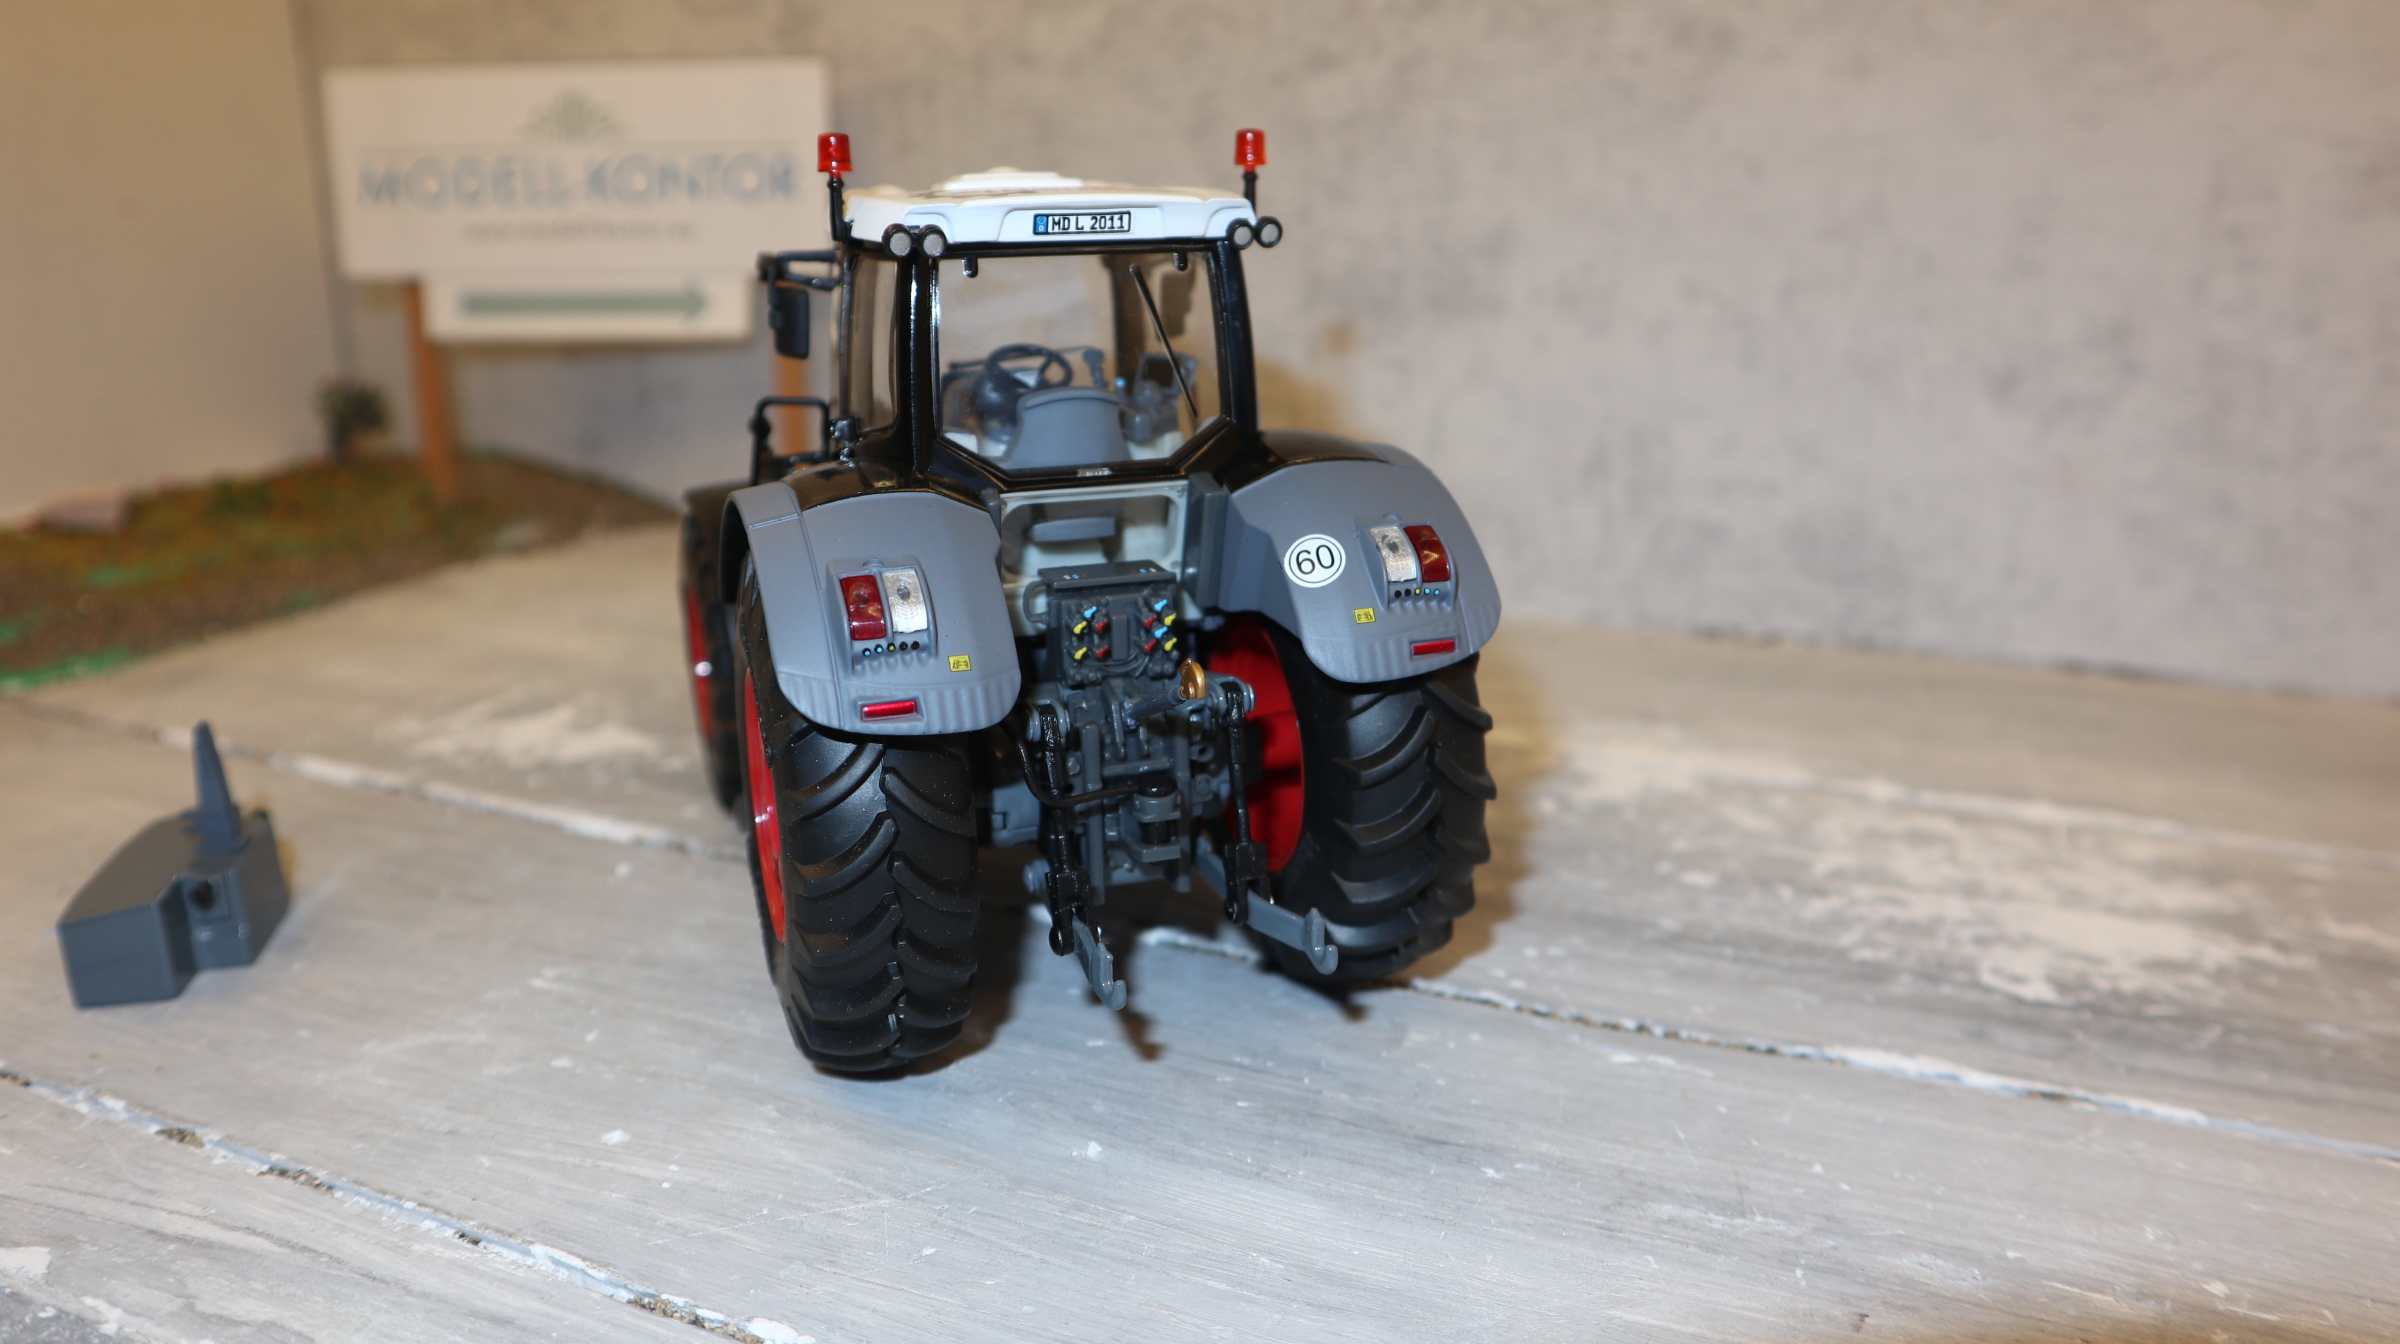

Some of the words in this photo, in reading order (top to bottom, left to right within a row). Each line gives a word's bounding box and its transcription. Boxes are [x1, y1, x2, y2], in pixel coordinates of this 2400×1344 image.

[1051, 216, 1071, 231] MD
[1075, 216, 1084, 231] L
[1090, 214, 1125, 230] 2011
[1296, 544, 1335, 575] 60
